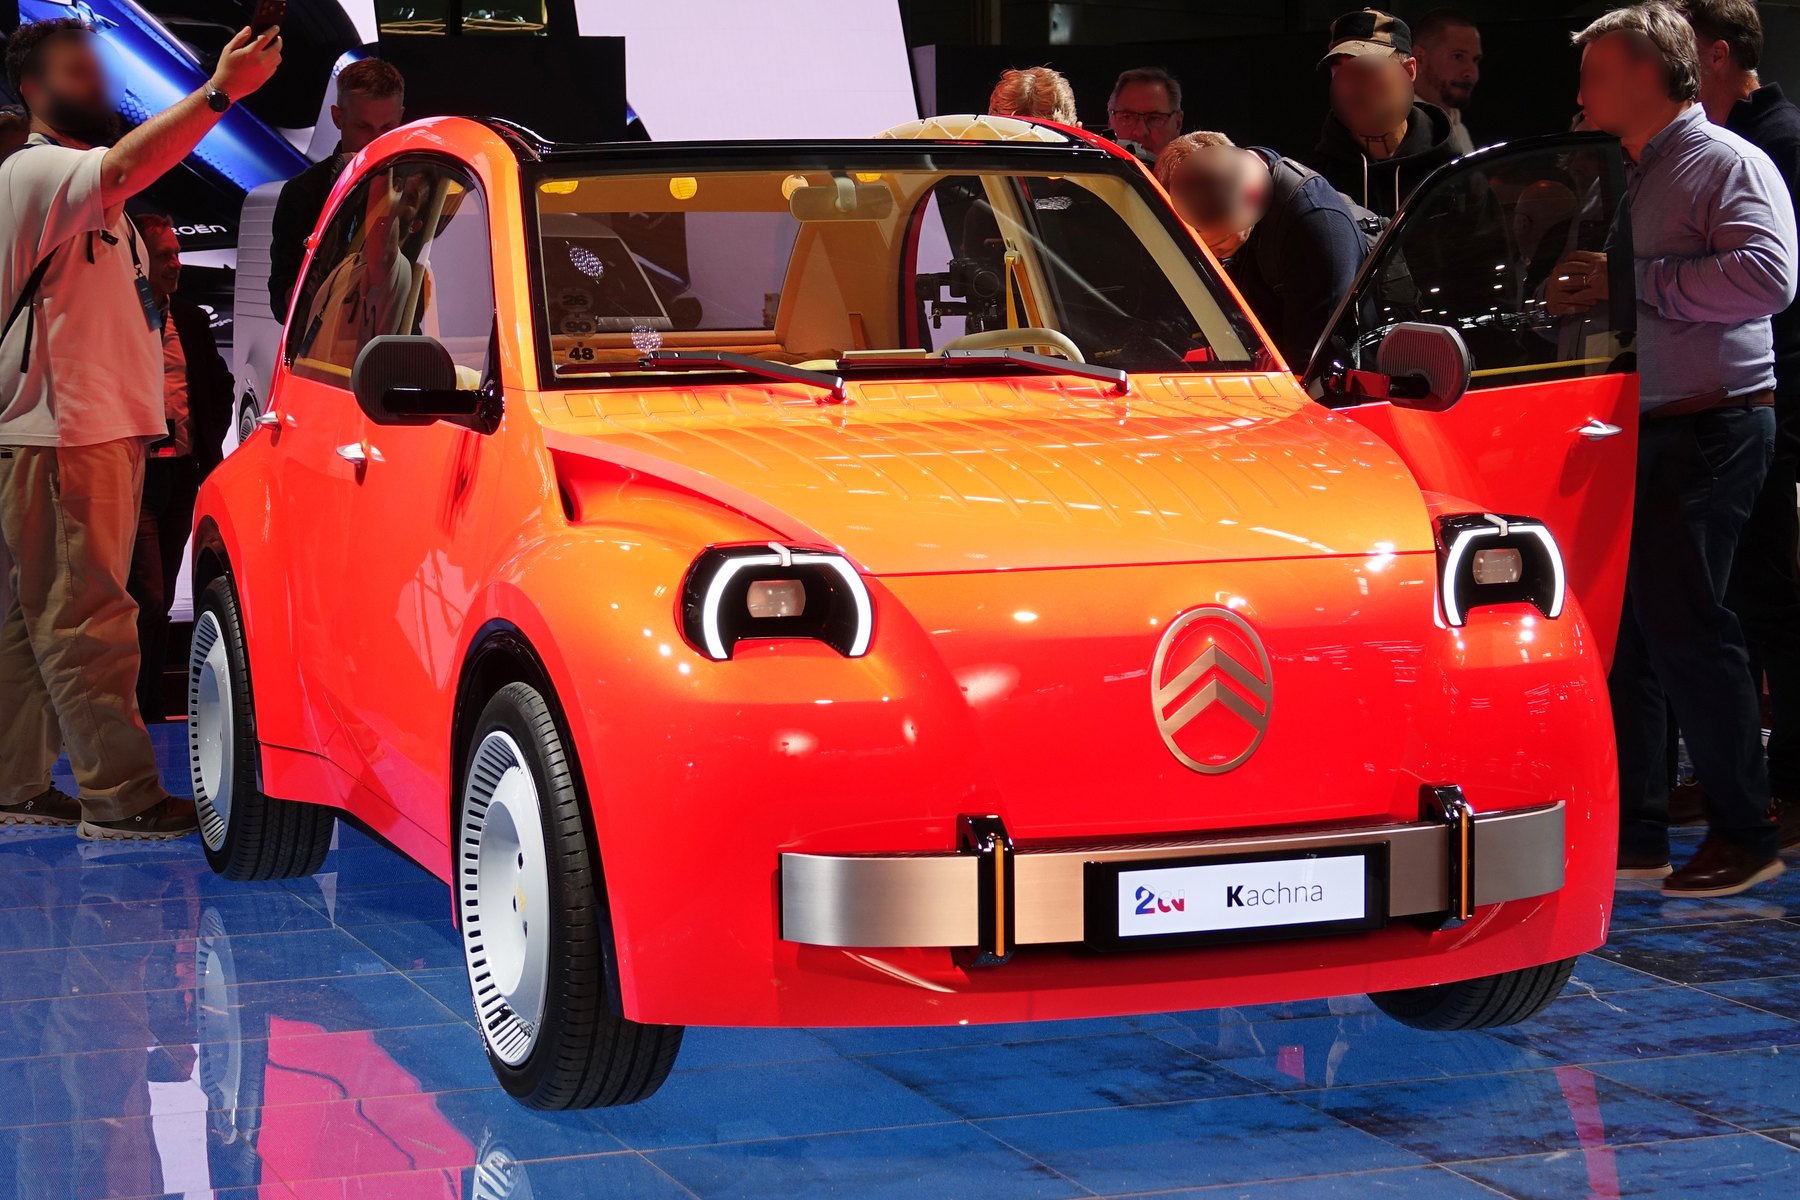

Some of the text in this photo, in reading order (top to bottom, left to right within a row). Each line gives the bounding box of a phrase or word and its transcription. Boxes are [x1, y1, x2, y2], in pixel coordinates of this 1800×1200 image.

[565, 321, 592, 333] 90
[569, 347, 595, 360] 48
[1227, 881, 1323, 908] Kachna
